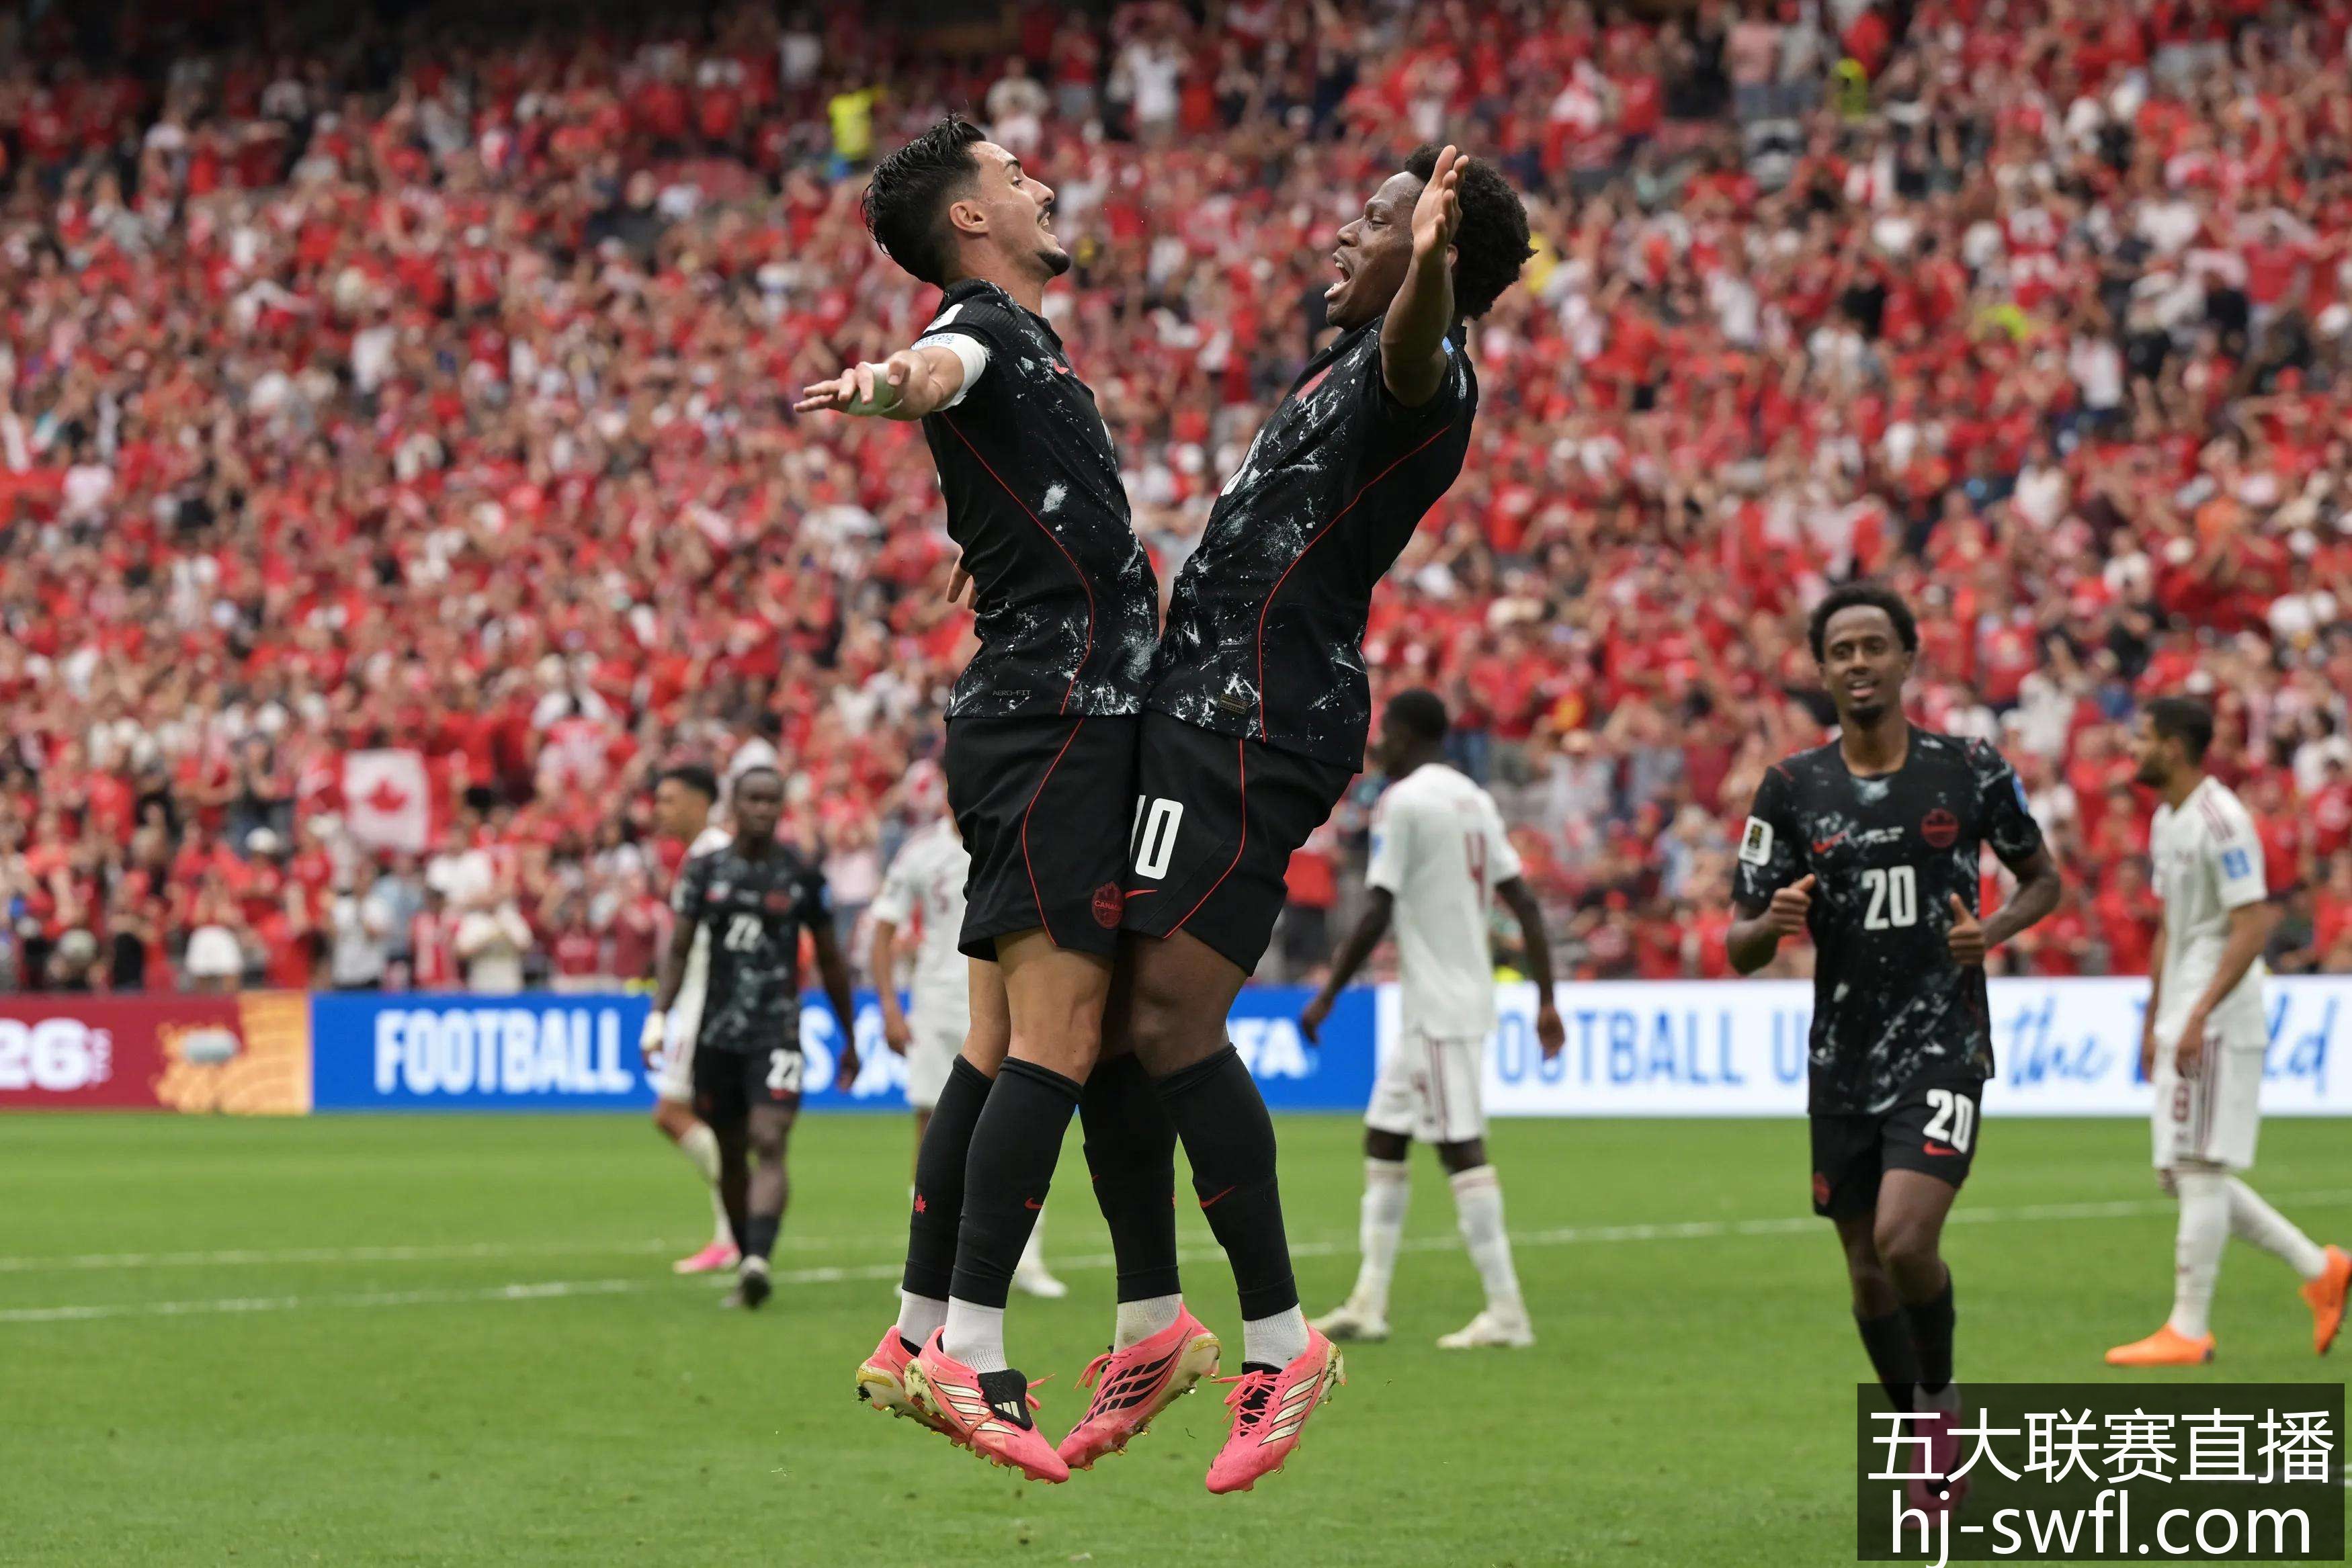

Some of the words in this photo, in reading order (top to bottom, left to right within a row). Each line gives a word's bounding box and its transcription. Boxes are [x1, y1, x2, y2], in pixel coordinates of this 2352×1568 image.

[1463, 830, 1487, 907] 4
[1861, 865, 1917, 930] 20
[375, 1008, 634, 1094] FOOTBALL
[765, 1048, 804, 1093] 22
[1230, 1017, 1309, 1079] FA
[1498, 1010, 1747, 1084] OTBALL
[1922, 1088, 1974, 1153] 20
